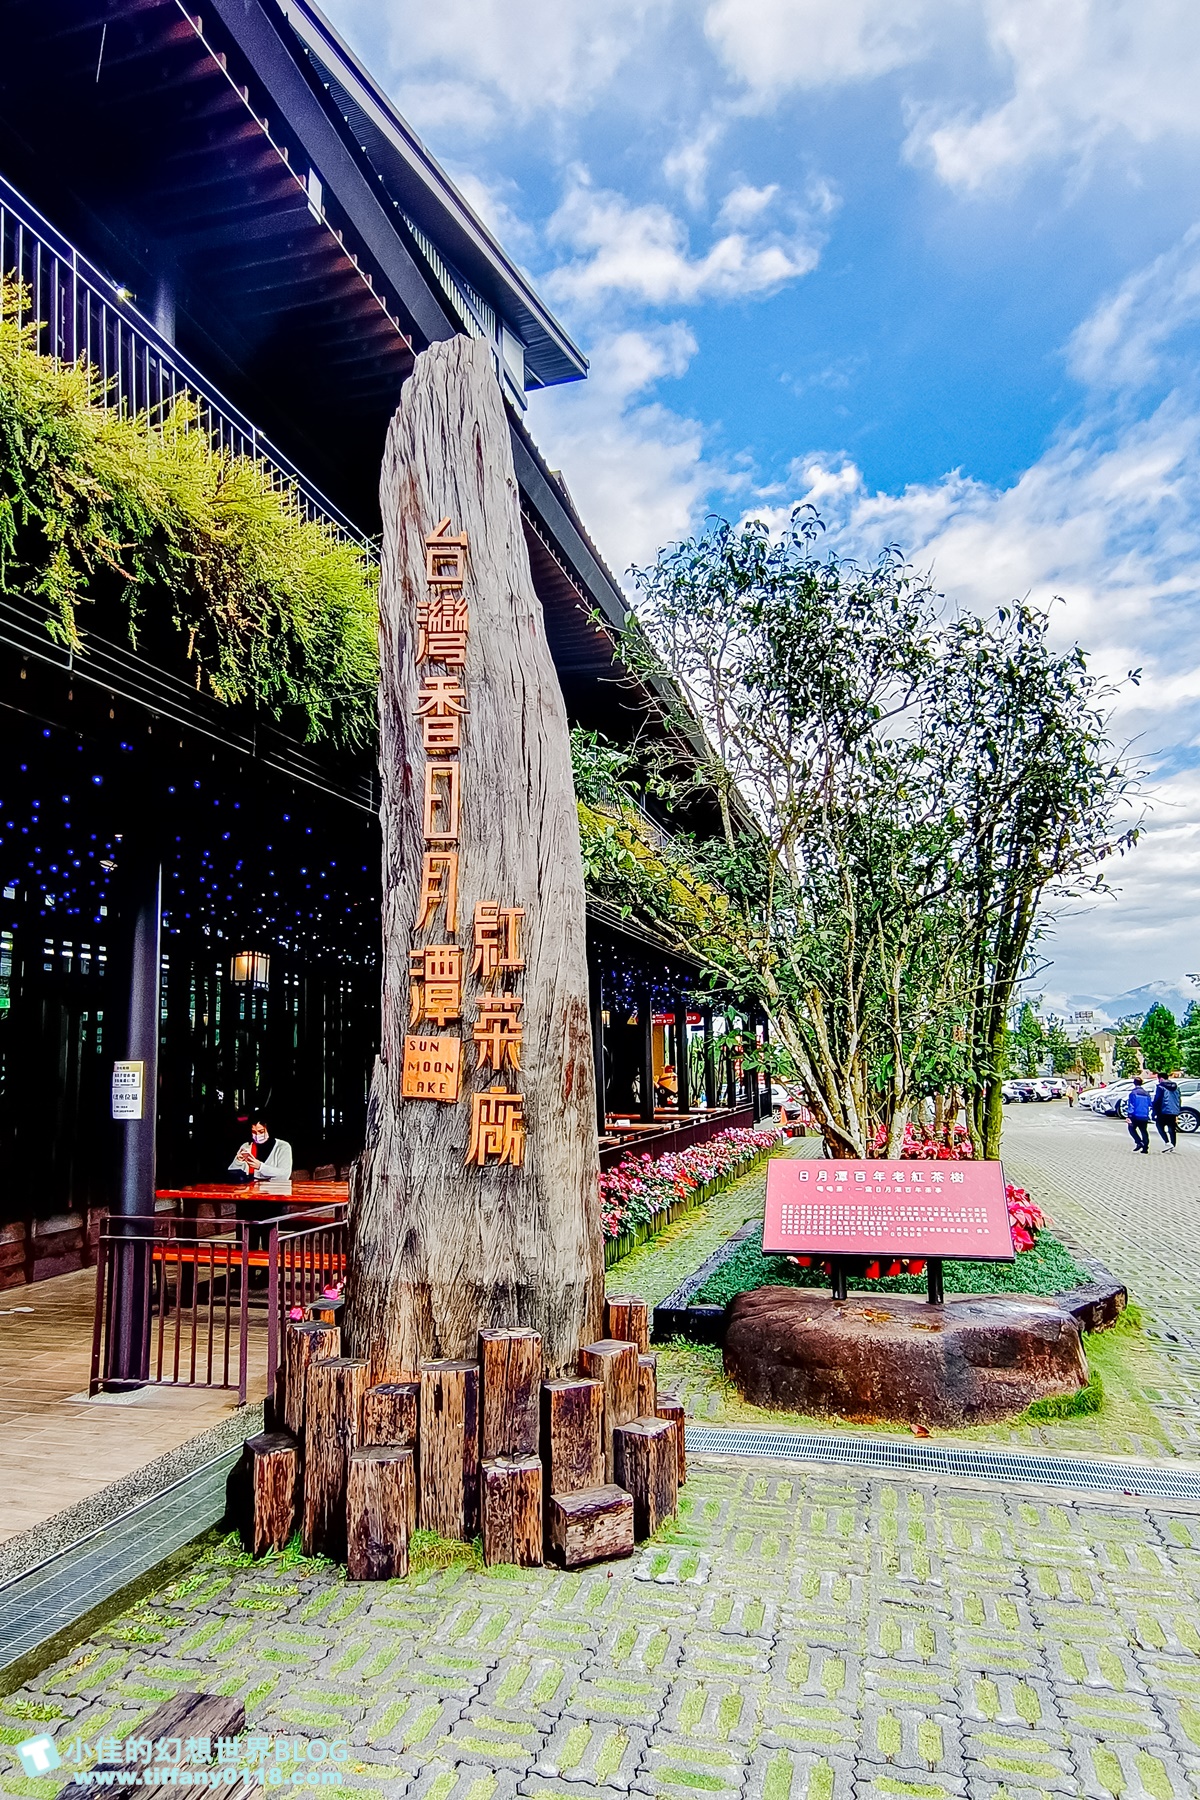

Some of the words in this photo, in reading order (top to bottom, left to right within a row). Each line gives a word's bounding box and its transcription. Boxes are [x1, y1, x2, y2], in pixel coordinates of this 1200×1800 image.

[465, 901, 527, 1167] 紅茶廠
[409, 1040, 439, 1052] SUN
[408, 1061, 454, 1073] MOON
[407, 1080, 446, 1093] LAKE
[799, 1171, 965, 1183] 日月潭百年老紅茶樹
